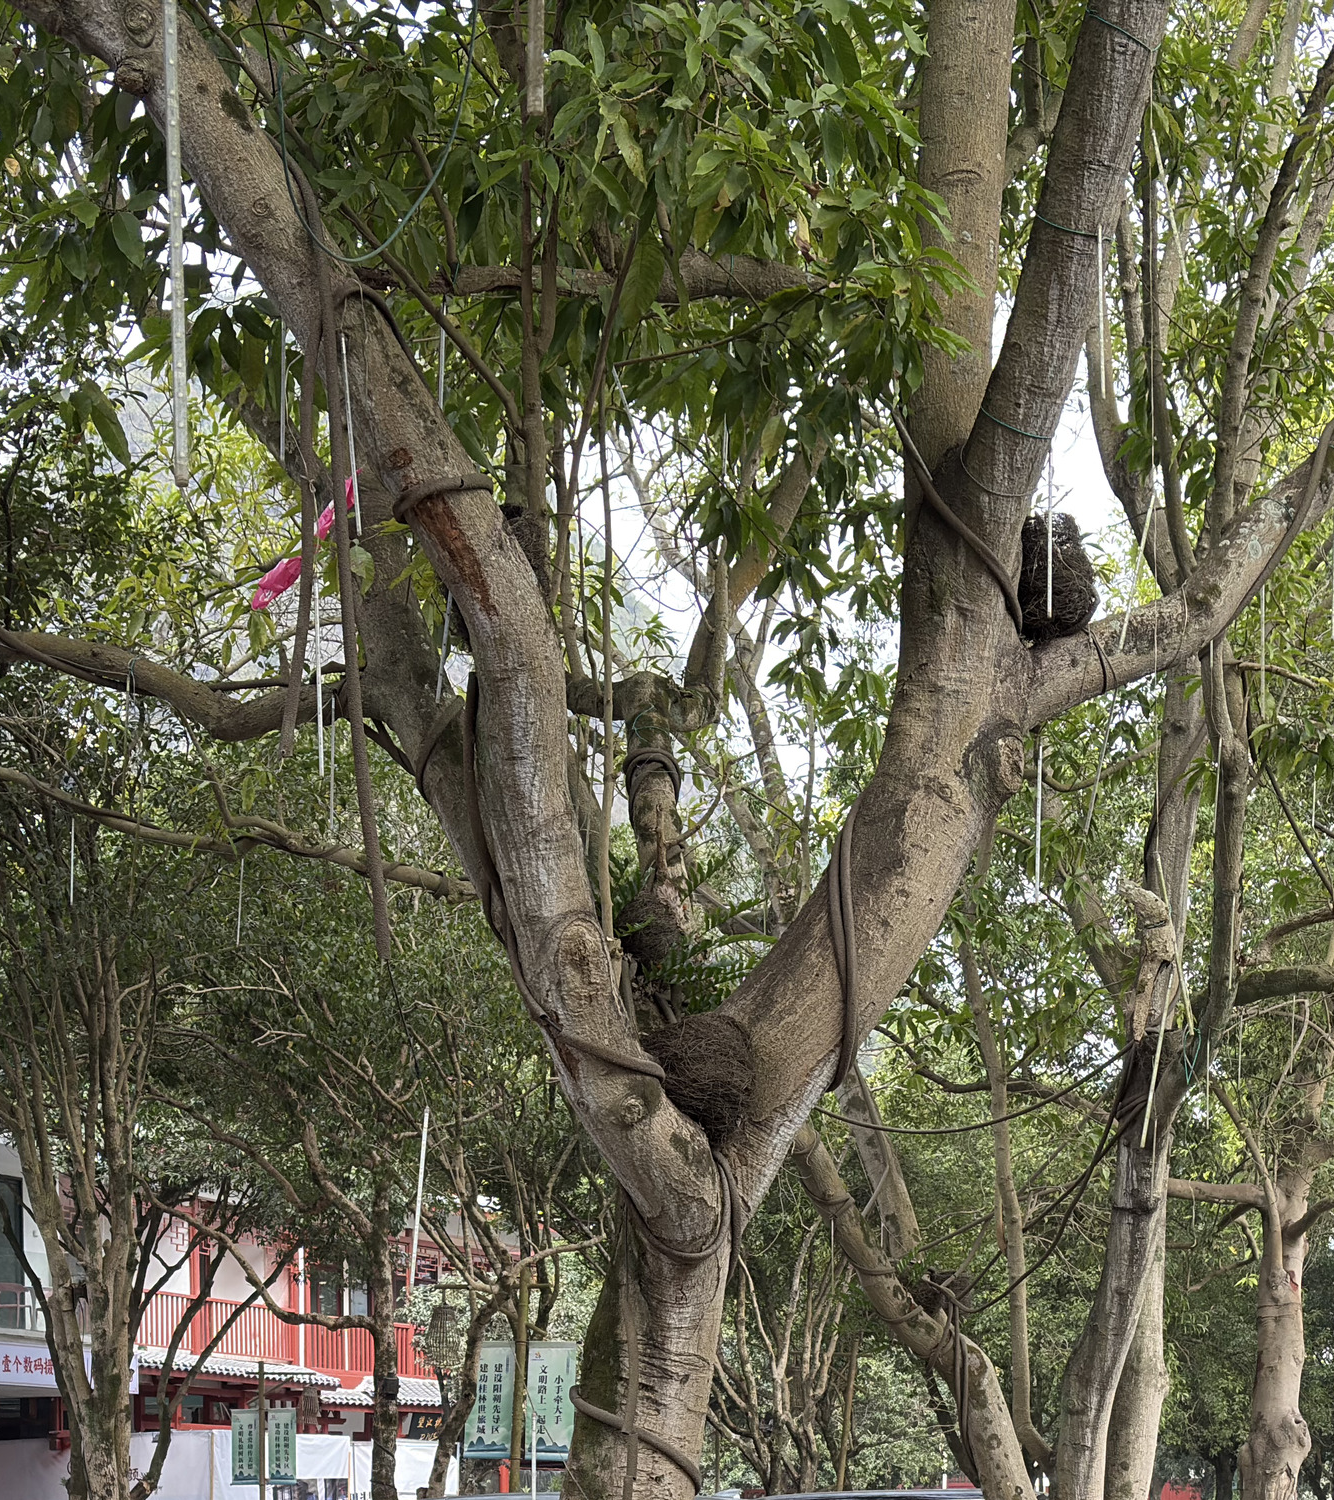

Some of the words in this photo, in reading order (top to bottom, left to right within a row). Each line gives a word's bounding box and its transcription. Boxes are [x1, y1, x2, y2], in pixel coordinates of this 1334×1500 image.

[476, 1363, 489, 1434] 建功桂林世旅城
[491, 1363, 504, 1434] 建设阳朔先导区
[536, 1364, 548, 1435] 文明路上一起走
[553, 1375, 564, 1425] 小手牵大手
